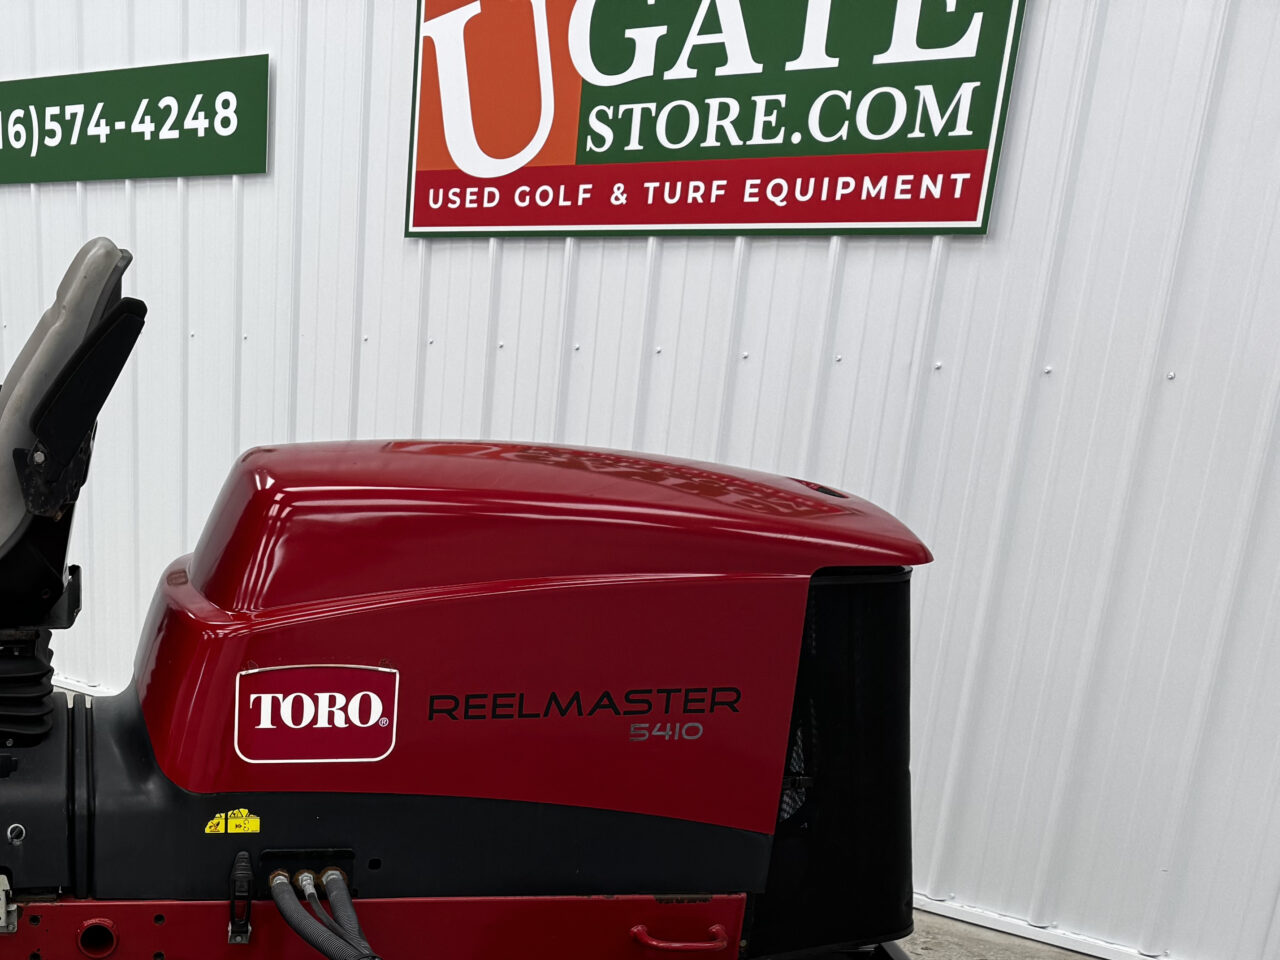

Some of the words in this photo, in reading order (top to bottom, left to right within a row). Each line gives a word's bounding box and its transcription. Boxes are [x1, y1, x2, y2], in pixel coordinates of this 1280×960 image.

[586, 81, 981, 152] STORE.COM
[428, 187, 500, 209] USED
[514, 183, 593, 208] GOLF
[610, 183, 628, 205] &
[643, 180, 728, 204] TURF
[744, 173, 971, 206] EQUIPMENT
[428, 687, 741, 720] REELMASTER
[629, 722, 704, 742] 5410
